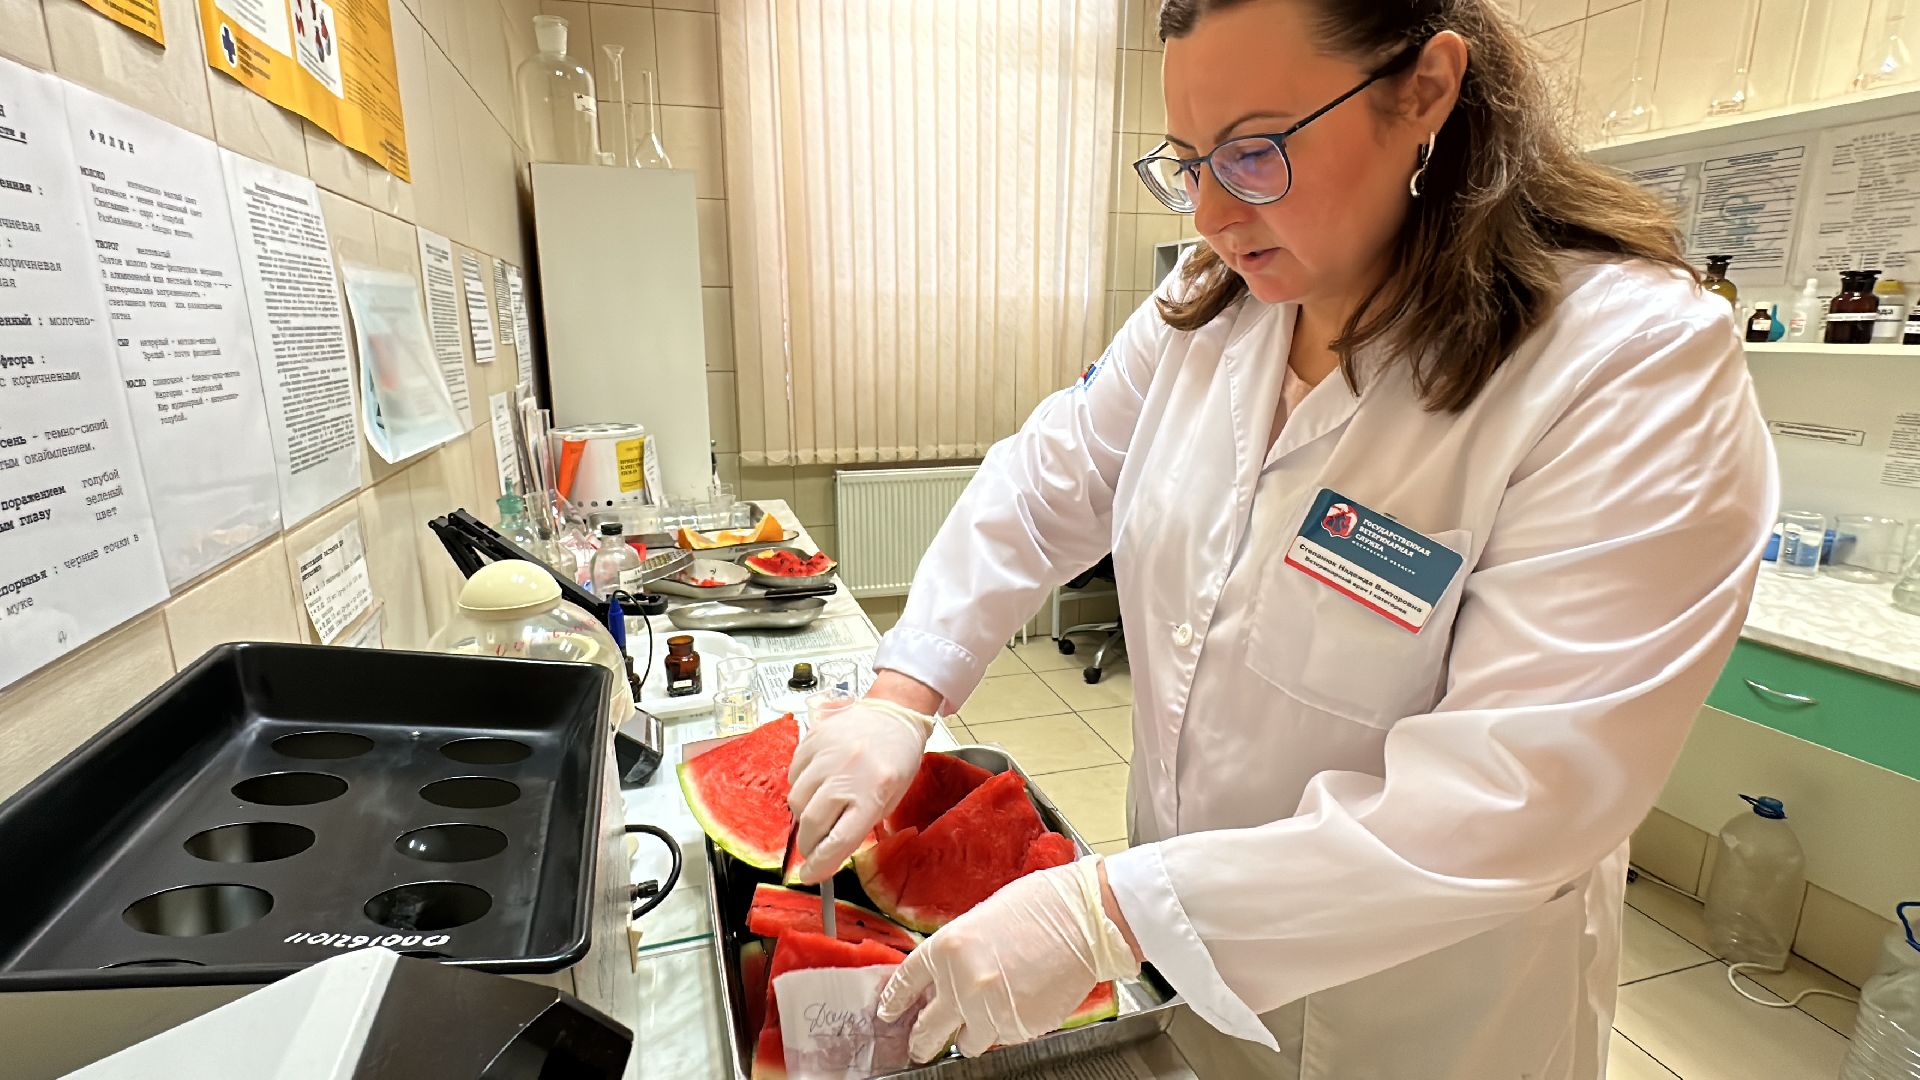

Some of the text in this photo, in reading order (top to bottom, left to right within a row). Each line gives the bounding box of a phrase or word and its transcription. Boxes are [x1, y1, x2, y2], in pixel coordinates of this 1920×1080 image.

[49, 317, 95, 326] молочно-
[0, 354, 34, 368] фтора
[12, 371, 81, 388] коричневыми
[0, 419, 109, 448] сень темно-синий
[24, 443, 96, 465] окаймлением.
[1, 469, 120, 511] поражением голубой
[19, 509, 51, 526] глазу
[85, 485, 124, 506] зеленый
[95, 507, 117, 521] цвет
[1355, 533, 1384, 553] СЛУЖБА
[1358, 525, 1414, 558] ВЕТЕРИНАРНАЯ
[1362, 518, 1432, 557] ГОСУДАРСТВЕННАЯ
[0, 570, 48, 597] порынья
[64, 549, 99, 568] черные
[104, 537, 130, 553] точки
[1338, 563, 1374, 587] Надежда
[1375, 583, 1422, 613] Викторовна
[6, 597, 34, 616] муке
